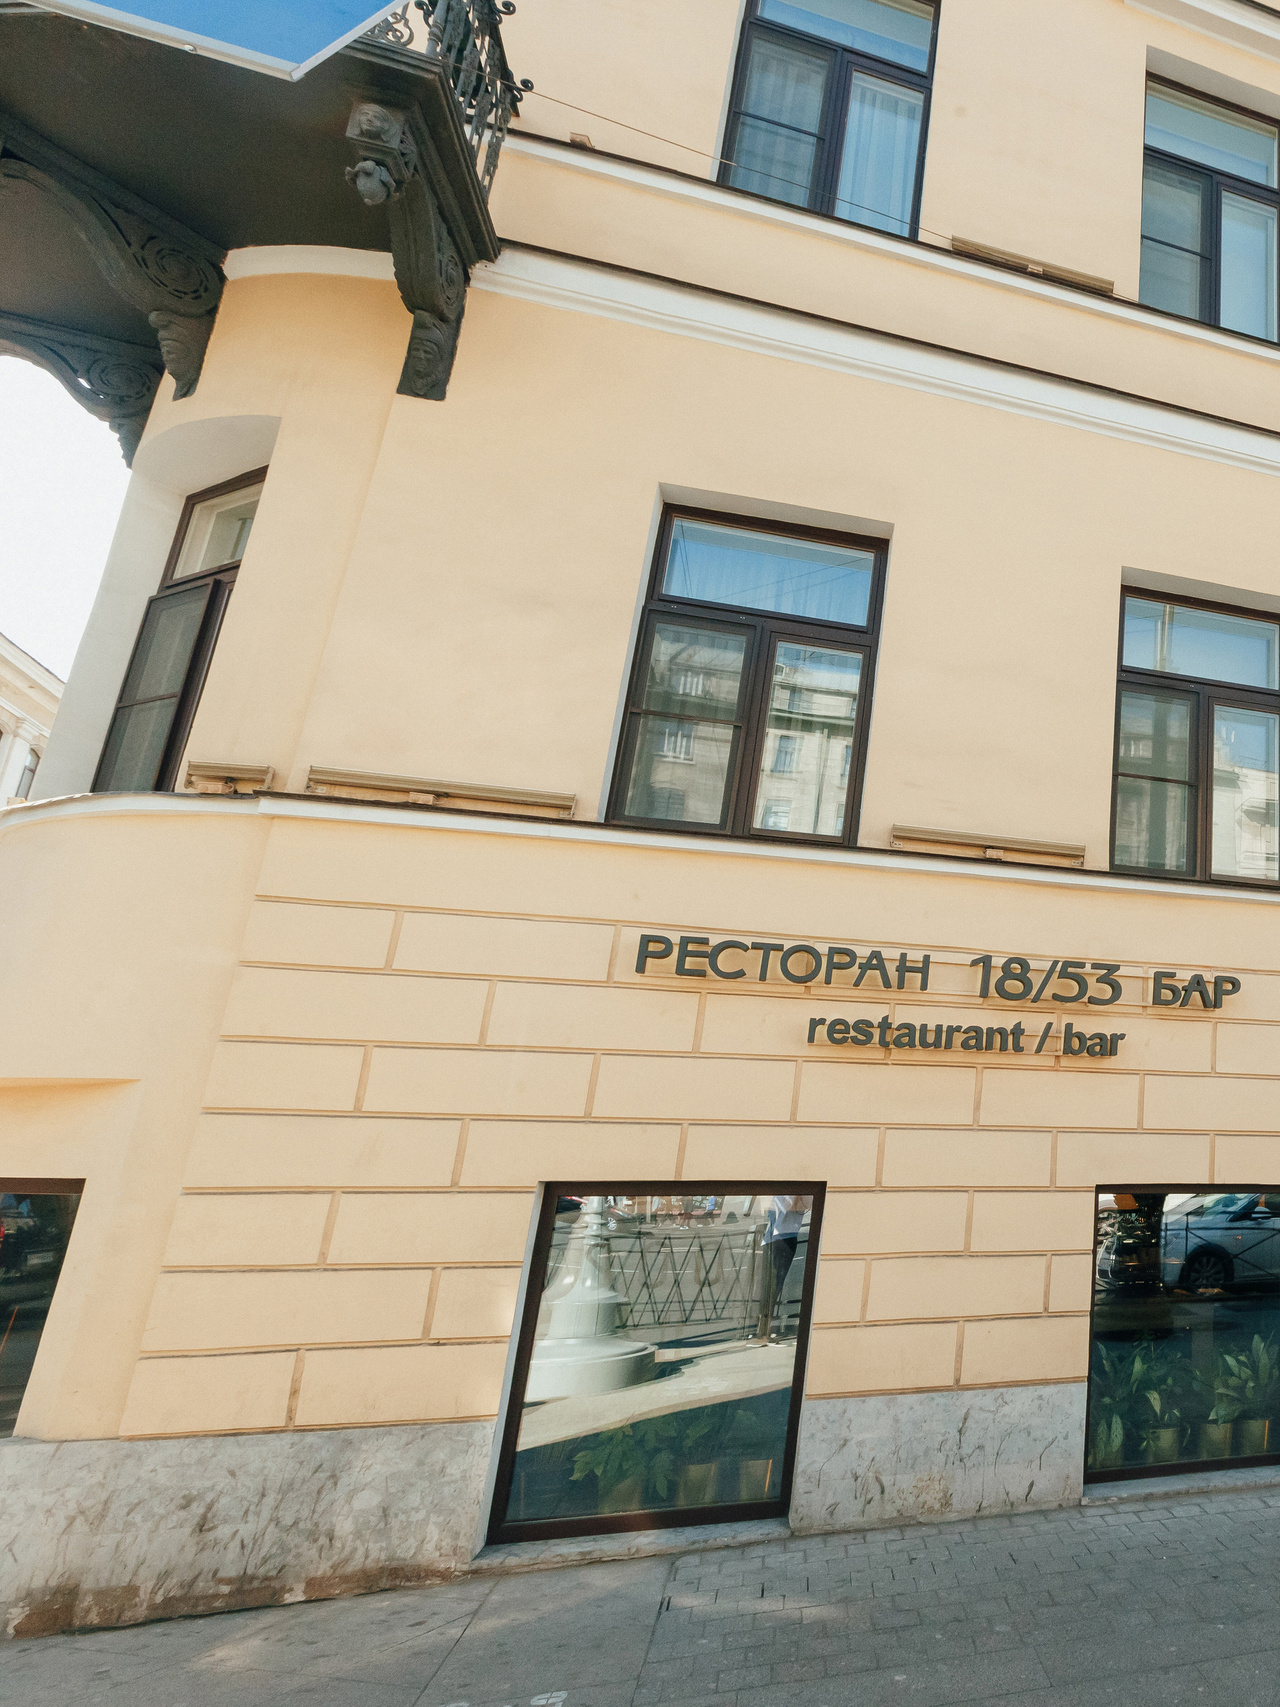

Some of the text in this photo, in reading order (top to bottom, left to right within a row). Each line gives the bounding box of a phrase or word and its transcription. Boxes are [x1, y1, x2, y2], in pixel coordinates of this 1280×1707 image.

[635, 933, 1243, 1010] РЕСТОРАН 18/53 БАР
[806, 1013, 1026, 1054] restaurant
[1064, 1022, 1126, 1057] bar
